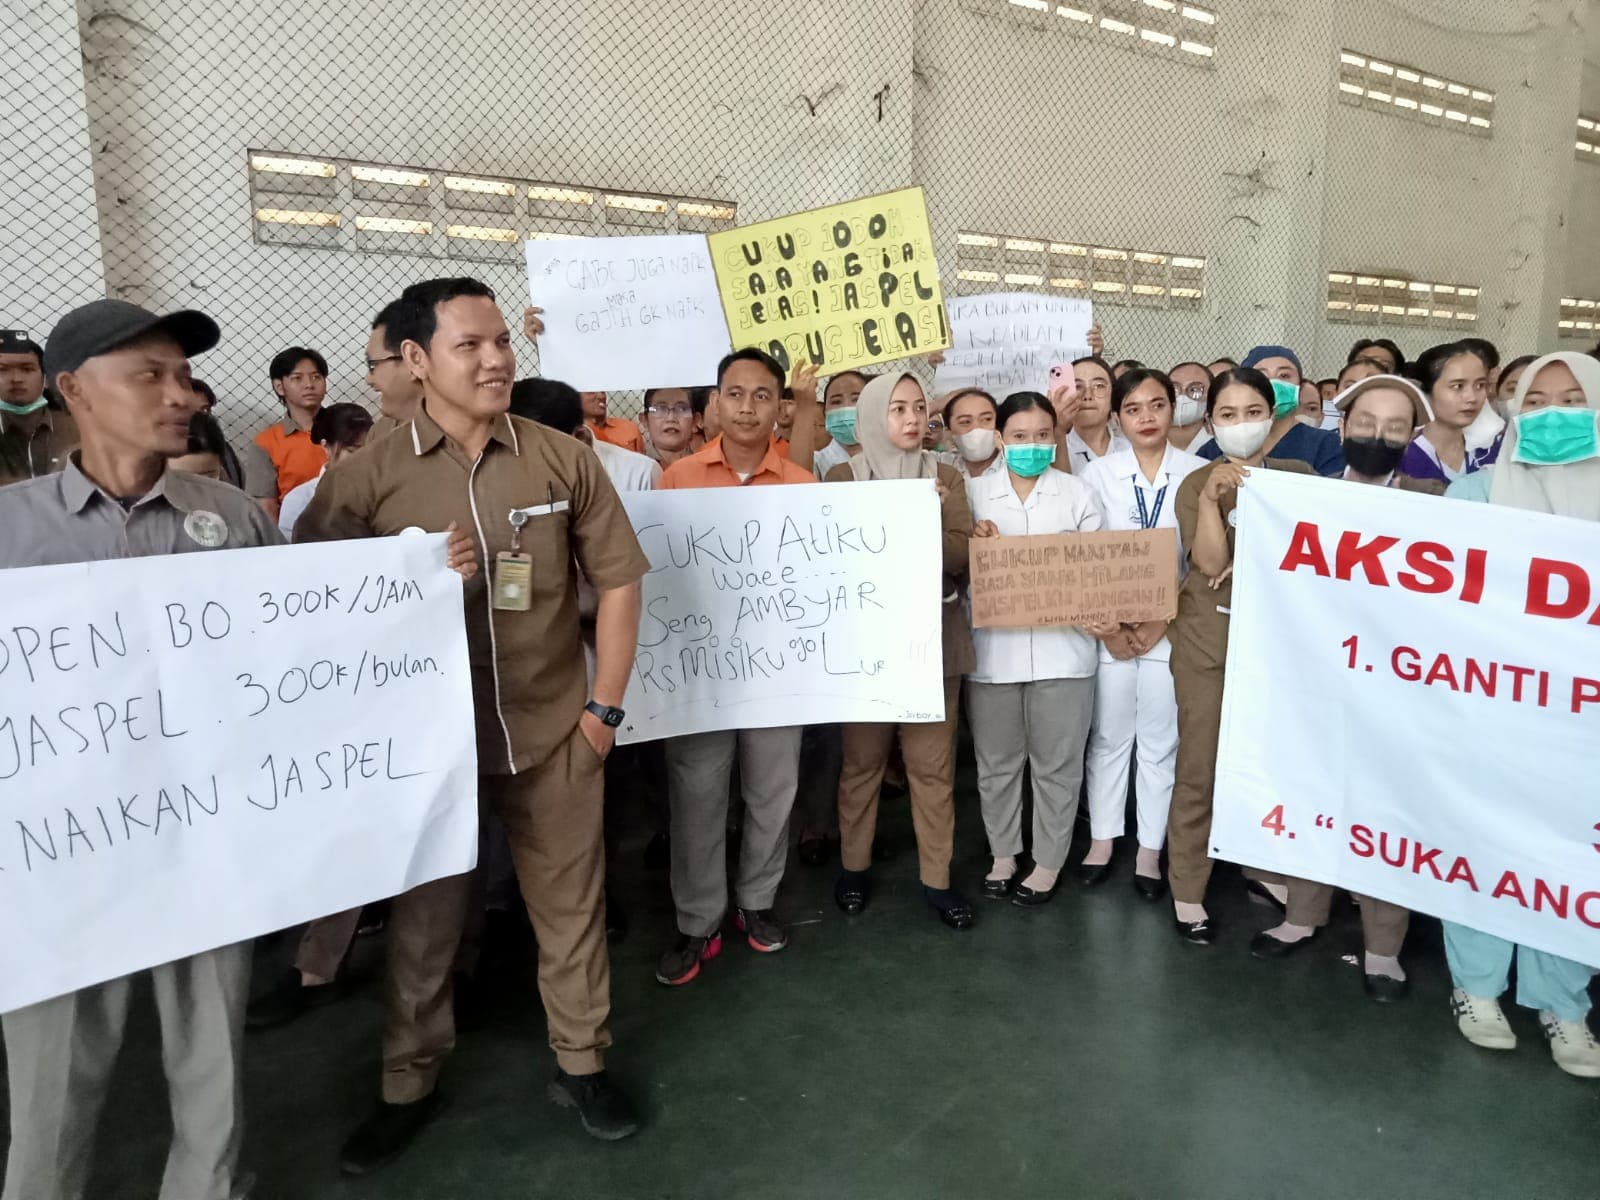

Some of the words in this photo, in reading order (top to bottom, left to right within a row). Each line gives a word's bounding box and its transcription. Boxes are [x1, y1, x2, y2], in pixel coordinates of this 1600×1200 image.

[723, 227, 812, 272] CUKUP
[731, 266, 793, 300] SAJA
[796, 251, 863, 287] YANG
[738, 288, 820, 330] JELAS!
[829, 270, 934, 312] JASPEL
[758, 324, 844, 371] ARUS
[848, 303, 947, 359] JELAS!
[1279, 521, 1488, 604] AKSI
[1342, 635, 1373, 672] 1.
[1391, 646, 1549, 707] GANTI
[16, 775, 219, 872] NAIKAN
[247, 737, 435, 811] JASPEL
[1261, 804, 1297, 840] 4.
[1348, 823, 1480, 893] SUKA
